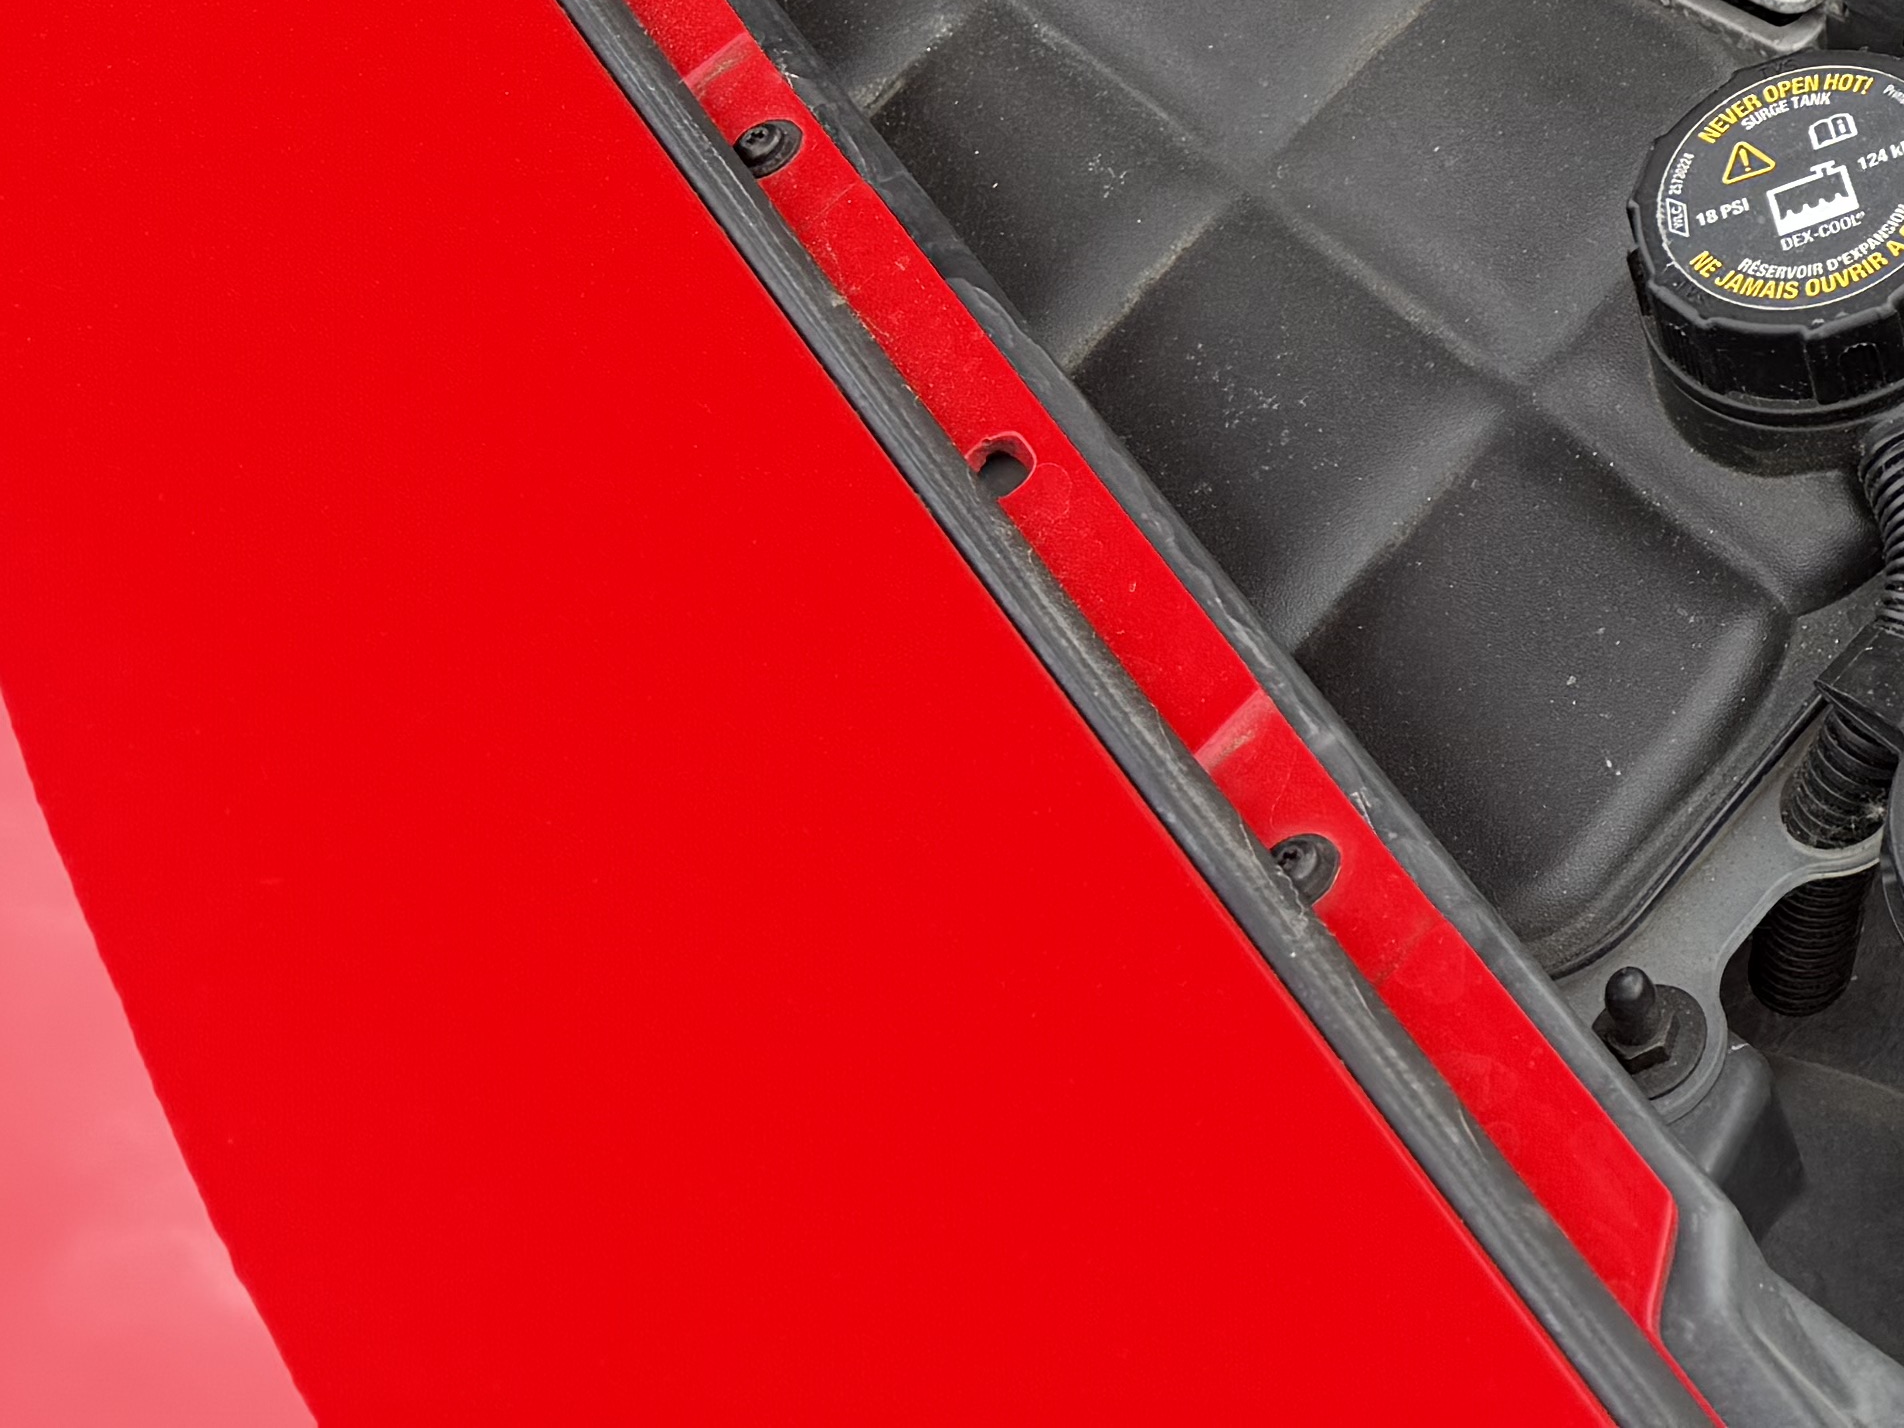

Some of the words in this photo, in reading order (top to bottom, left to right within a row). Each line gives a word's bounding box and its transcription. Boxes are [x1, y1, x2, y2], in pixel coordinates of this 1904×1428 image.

[1697, 93, 1763, 144] NEVER
[1762, 73, 1820, 103] OPEN
[1823, 73, 1874, 95] HOT!
[1740, 99, 1790, 131] SURGE
[1790, 91, 1832, 110] TANK
[1857, 148, 1889, 171] 124
[1695, 208, 1719, 226] 18
[1719, 197, 1750, 219] PSI
[1689, 250, 1723, 278] NE
[1714, 269, 1799, 300] JAMAIS
[1804, 251, 1889, 297] OUVRIR
[1737, 257, 1824, 280] RÉSERVOIR
